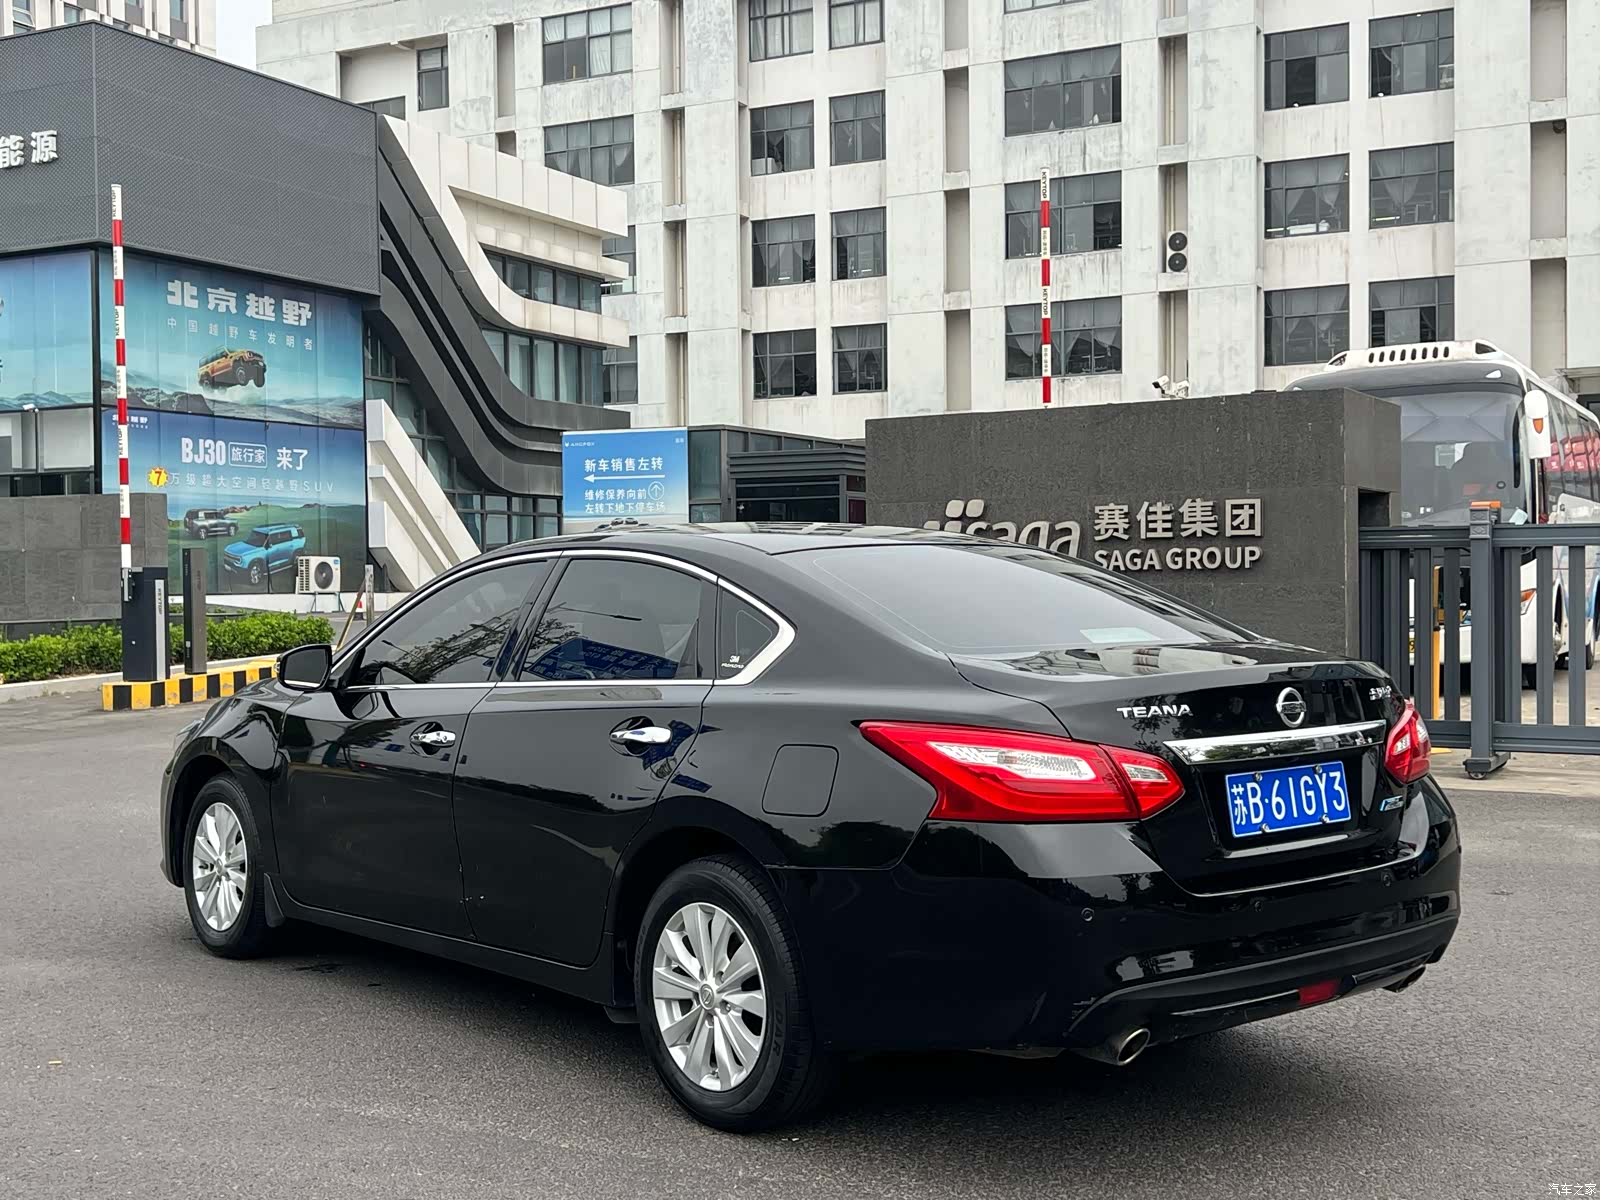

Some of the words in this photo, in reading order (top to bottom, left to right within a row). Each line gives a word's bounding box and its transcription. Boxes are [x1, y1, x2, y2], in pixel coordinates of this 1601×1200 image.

[166, 279, 313, 327] 北京越野
[167, 317, 314, 351] 中国越野车发明者
[181, 437, 226, 466] BJ30
[231, 447, 266, 464] 旅行家
[276, 447, 309, 471] 来了
[584, 456, 664, 473] 新车销售左转
[584, 488, 647, 501] 维修保养向前
[585, 501, 665, 514] 左转下地下停车场
[1093, 498, 1264, 541] 赛佳集团
[1094, 548, 1162, 571] SAGA
[1166, 545, 1262, 570] GROUP
[1116, 704, 1193, 719] TEANA
